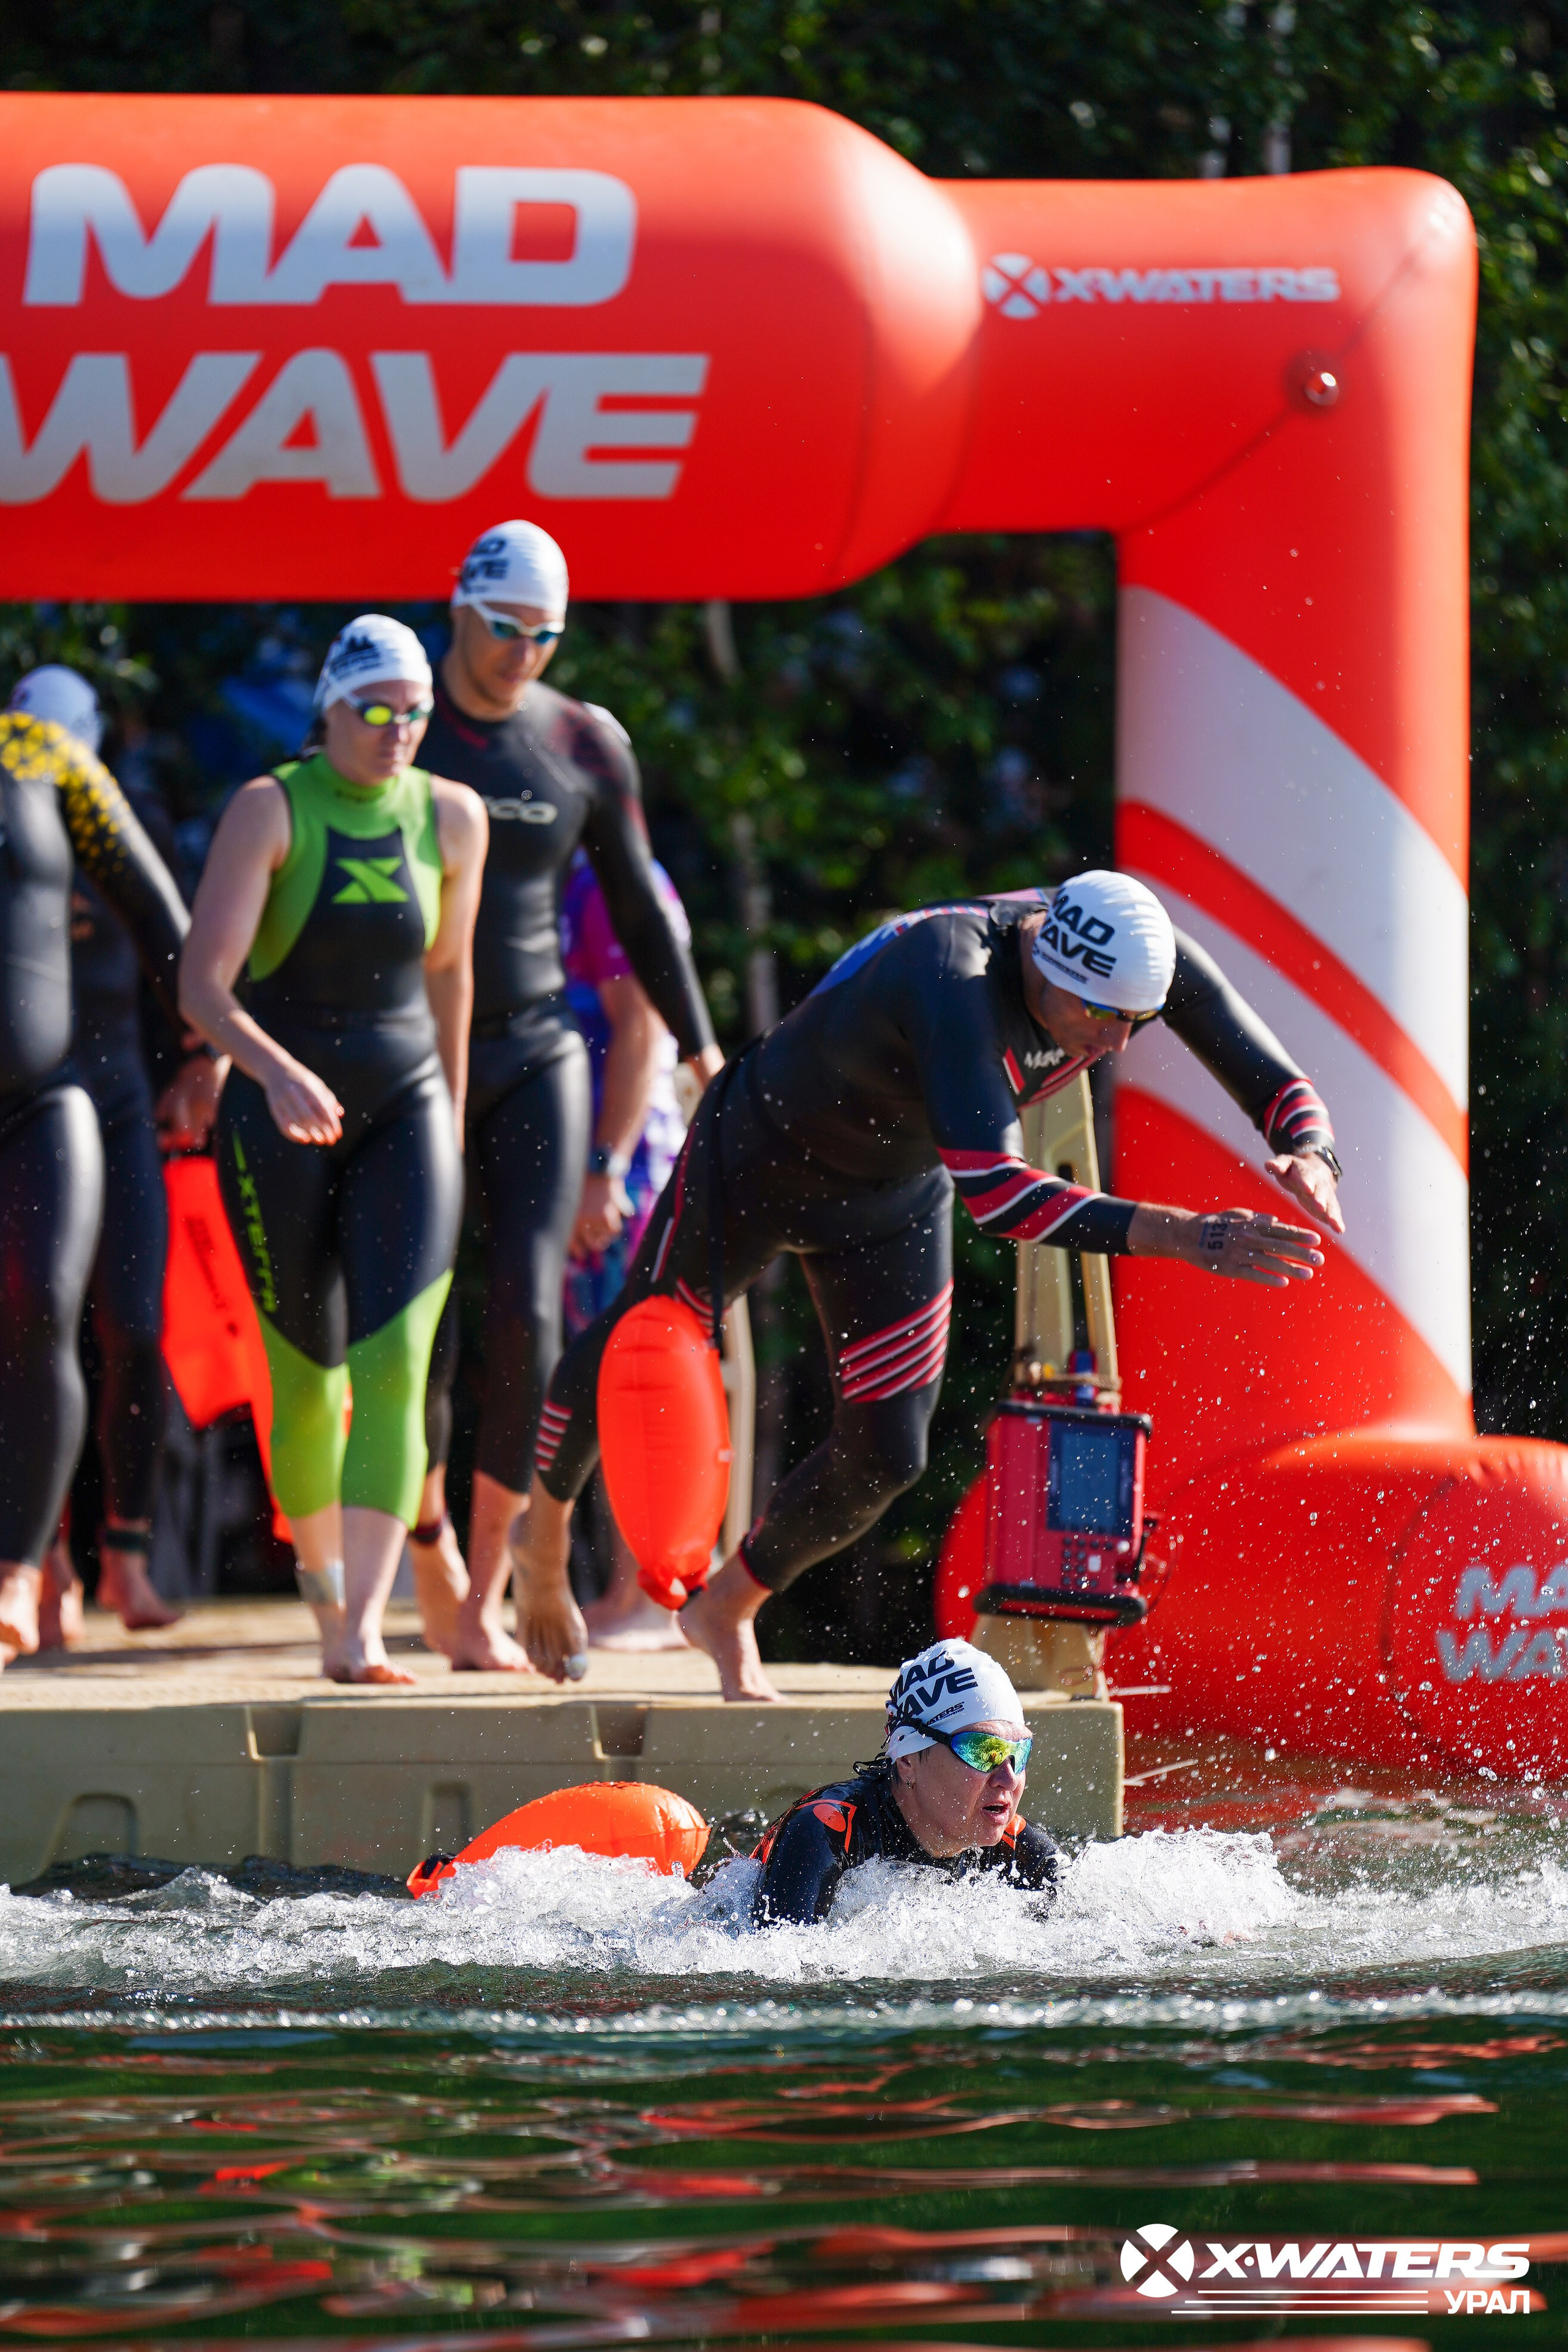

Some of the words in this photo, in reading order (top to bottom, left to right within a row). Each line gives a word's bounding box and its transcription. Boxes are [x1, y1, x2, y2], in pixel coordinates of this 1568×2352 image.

[21, 162, 639, 306] MAD
[0, 346, 711, 505] WAVE
[1041, 917, 1118, 979] AVE
[1207, 1223, 1228, 1250] 513
[1435, 1628, 1568, 1683] WA
